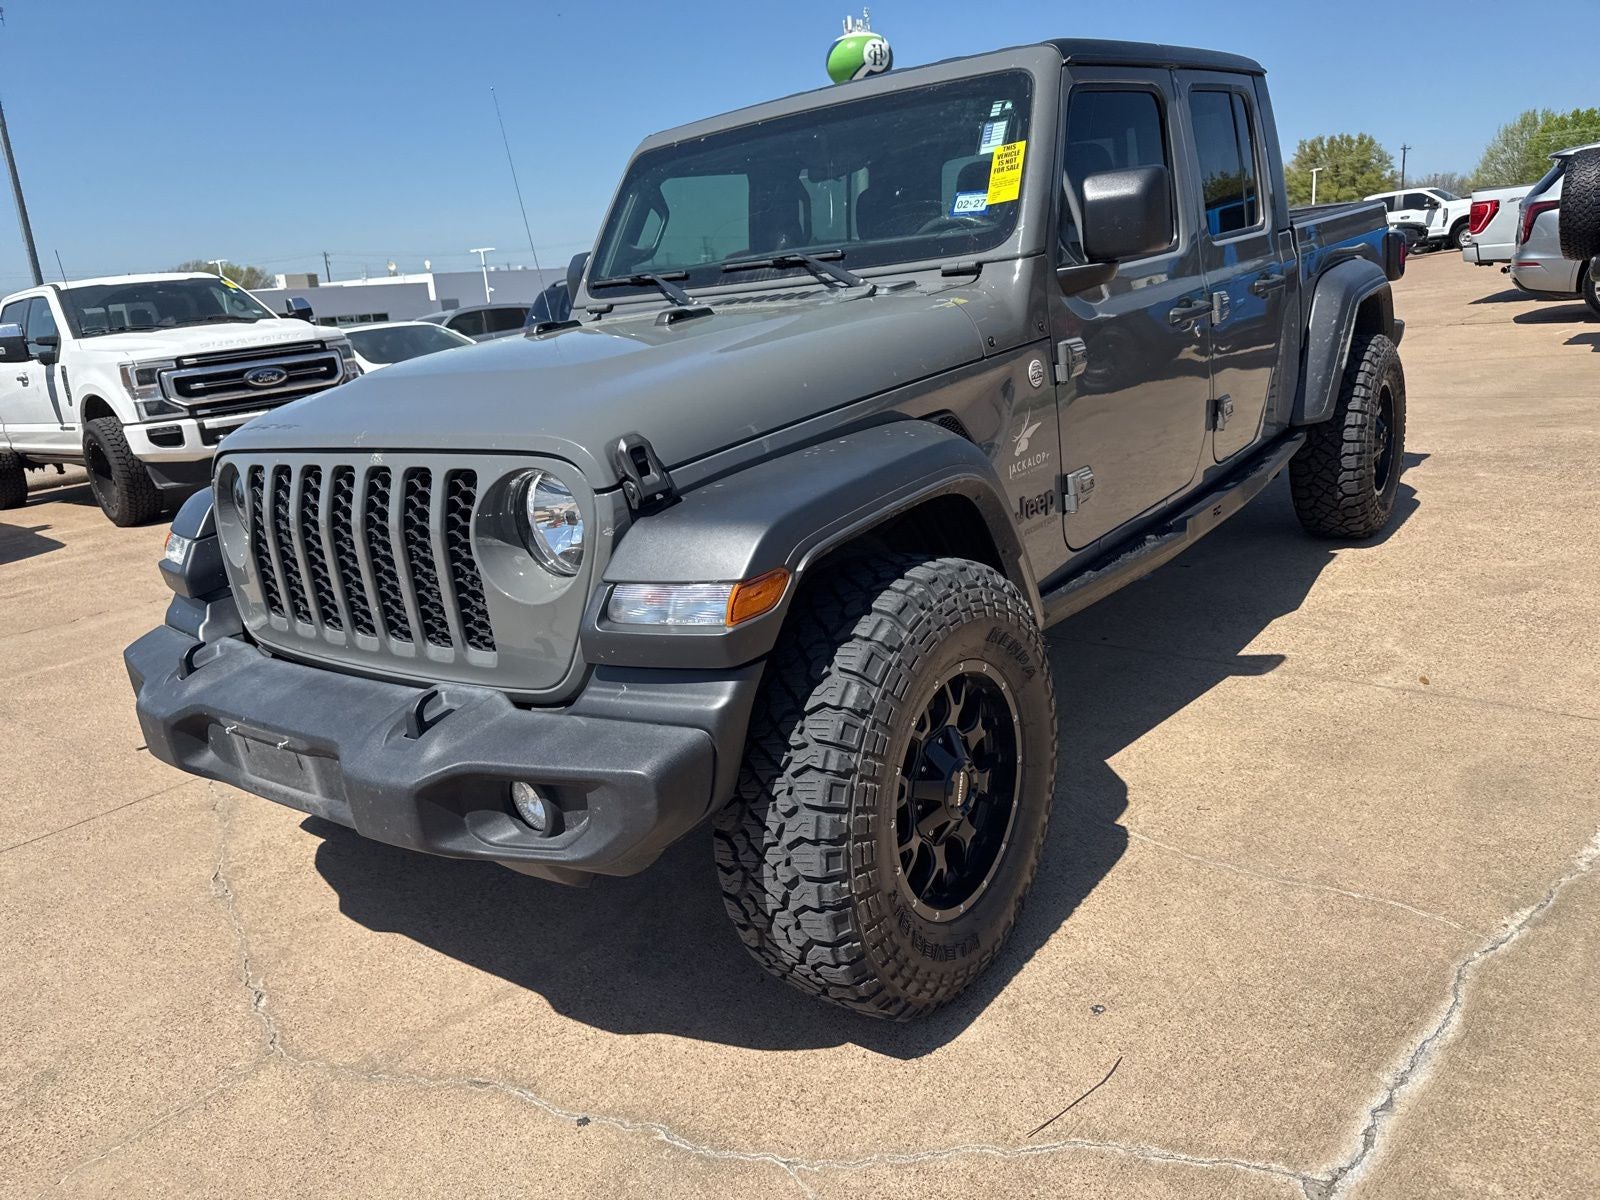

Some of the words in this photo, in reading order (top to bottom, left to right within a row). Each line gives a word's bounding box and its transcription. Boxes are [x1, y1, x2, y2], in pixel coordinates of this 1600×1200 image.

[1003, 144, 1017, 152] THIS
[997, 149, 1020, 160] VEHICLE
[1005, 157, 1017, 165] NOT
[993, 165, 1005, 174] FOR
[1005, 163, 1020, 172] SALE
[1015, 490, 1055, 525] Jeep
